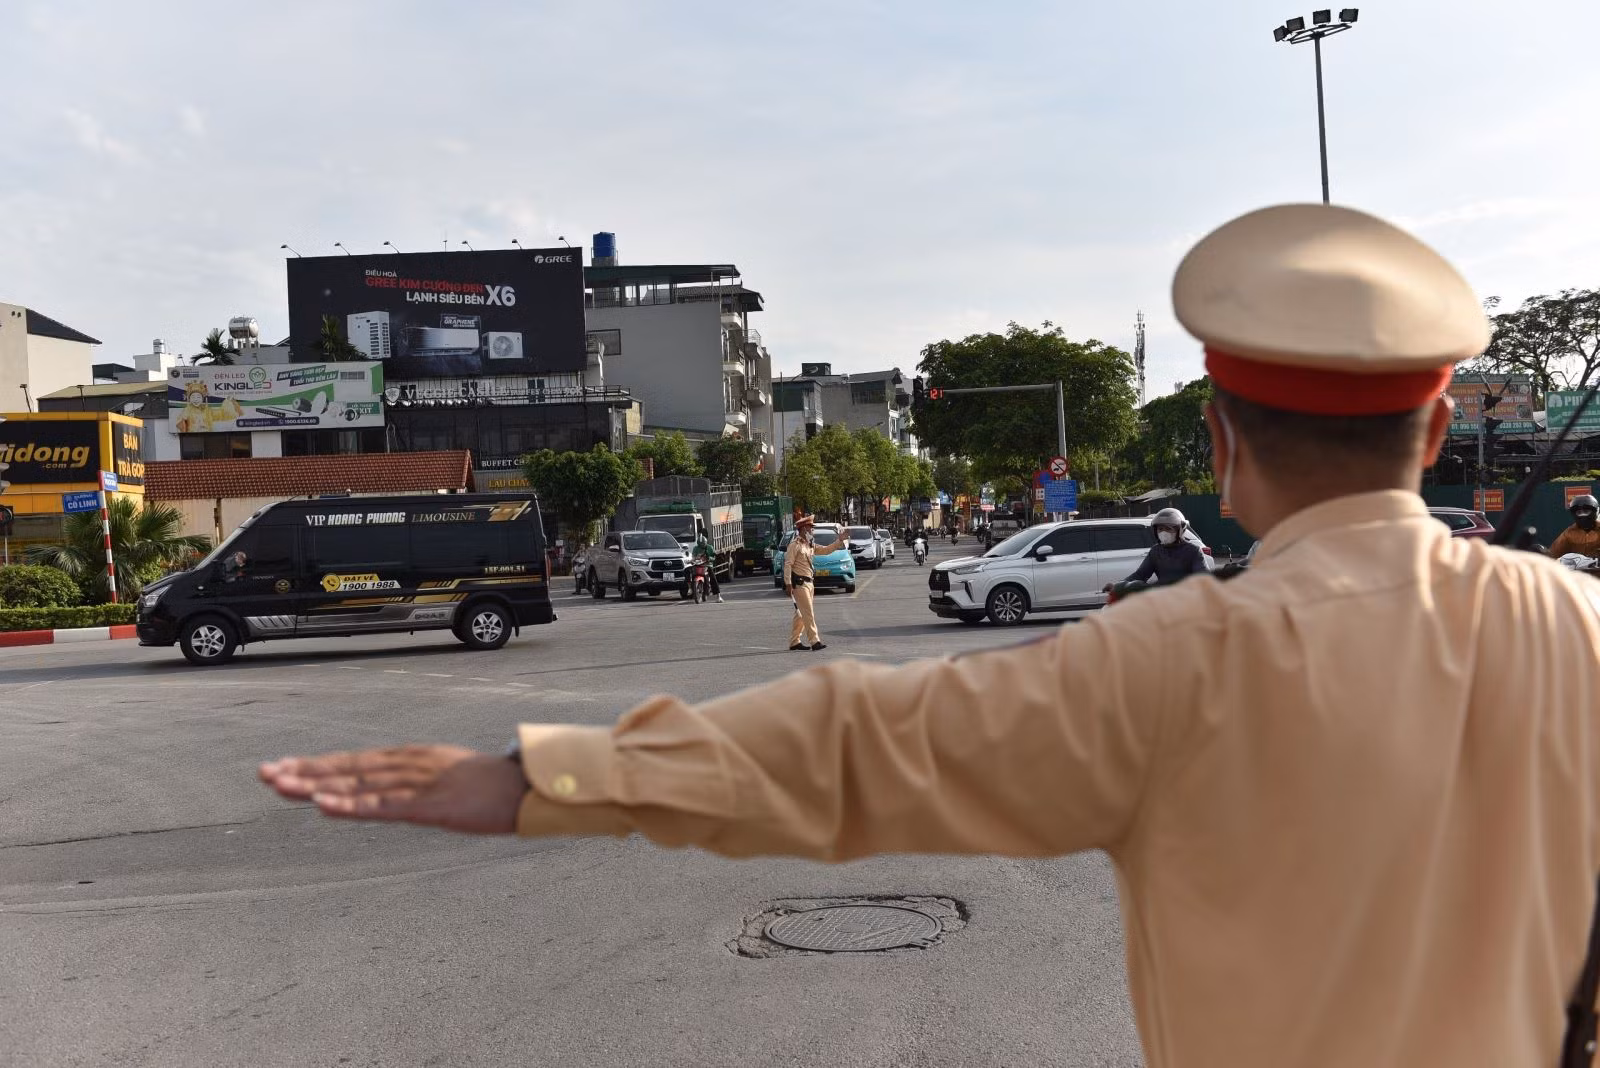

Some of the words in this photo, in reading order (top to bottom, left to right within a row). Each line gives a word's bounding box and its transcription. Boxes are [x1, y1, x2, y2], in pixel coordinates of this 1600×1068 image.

[545, 255, 572, 263] GREE
[366, 277, 397, 288] GREE
[399, 278, 420, 289] KIM
[406, 291, 438, 304] LẠNH
[439, 291, 463, 304] SIÊU
[485, 284, 516, 307] X6
[214, 381, 272, 391] KINGLED
[123, 432, 138, 450] BÁN
[481, 459, 512, 467] BUFFET
[79, 499, 97, 508] LINH
[305, 515, 326, 526] VIP
[411, 511, 476, 523] LIMOUSINE
[343, 582, 367, 590] 1900
[370, 581, 395, 589] 1988
